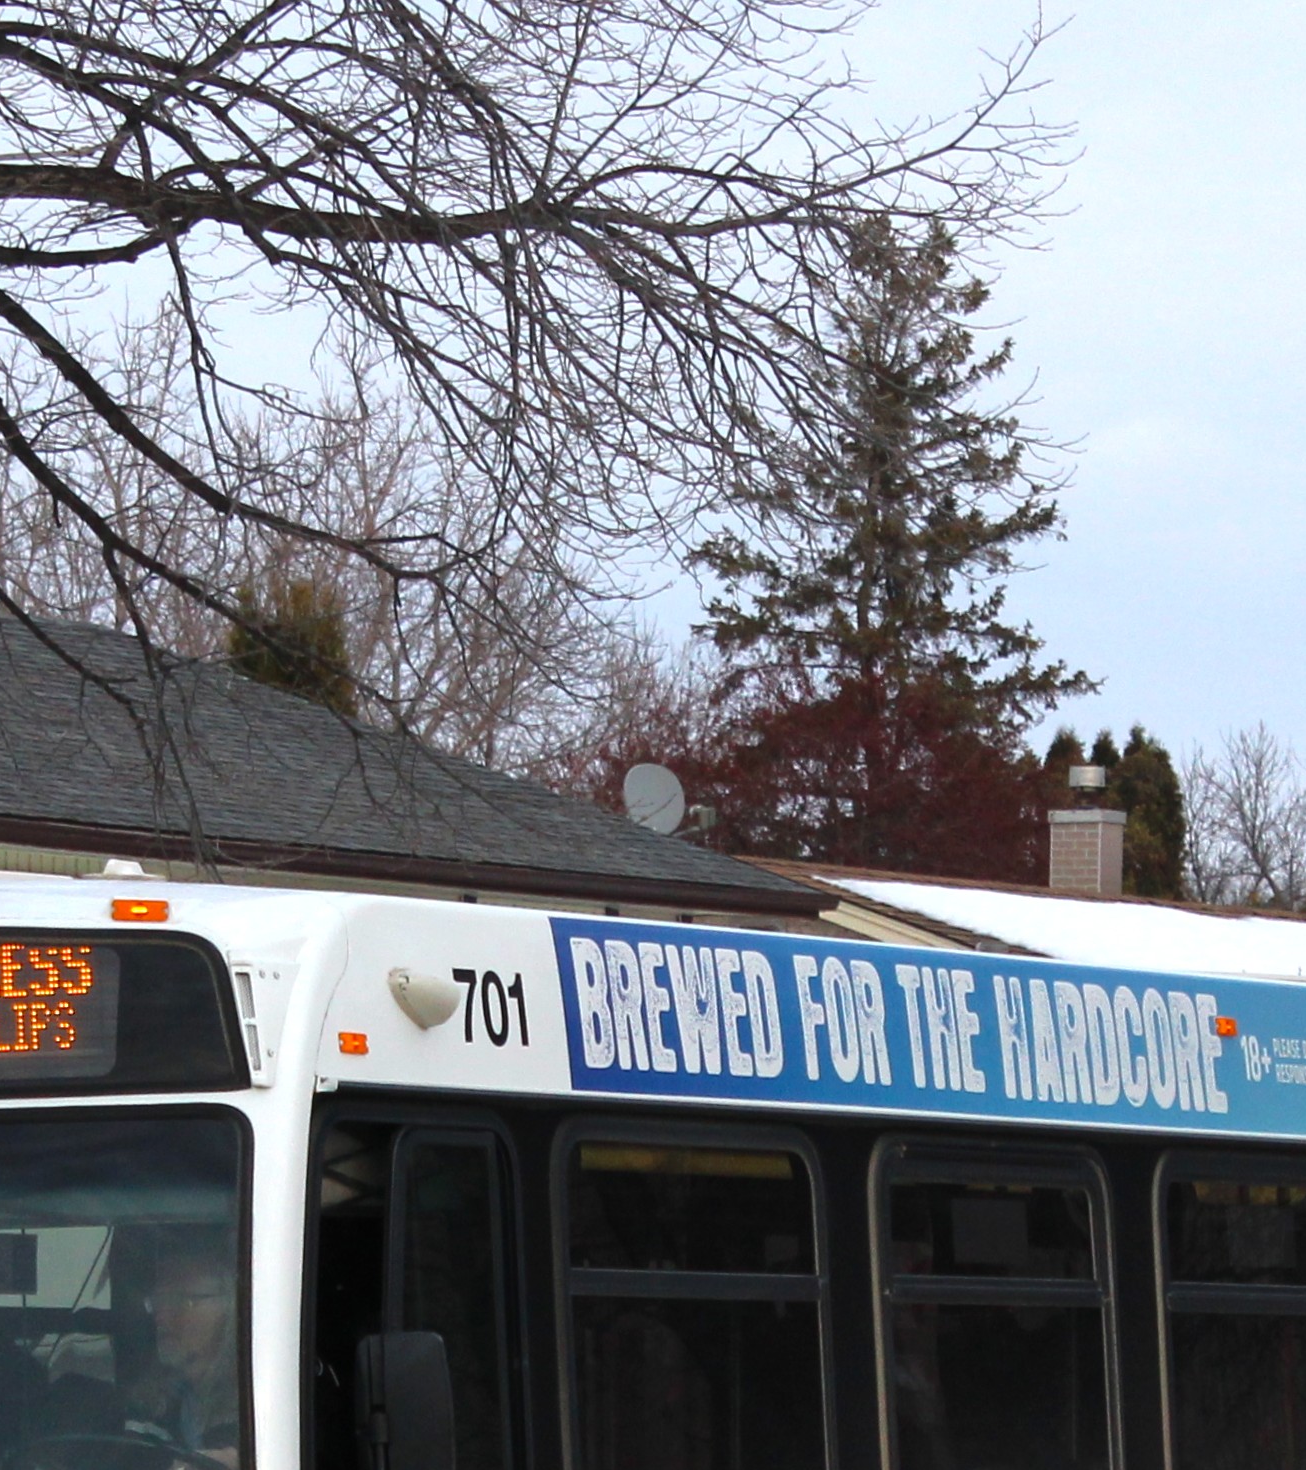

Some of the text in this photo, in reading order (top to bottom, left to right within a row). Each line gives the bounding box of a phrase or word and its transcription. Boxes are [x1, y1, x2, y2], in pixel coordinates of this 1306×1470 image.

[452, 968, 529, 1047] 701
[569, 937, 1228, 1114] BREWED FOR THE HARDCORE
[1240, 1034, 1272, 1083] 18+
[1272, 1037, 1301, 1059] PLEASE
